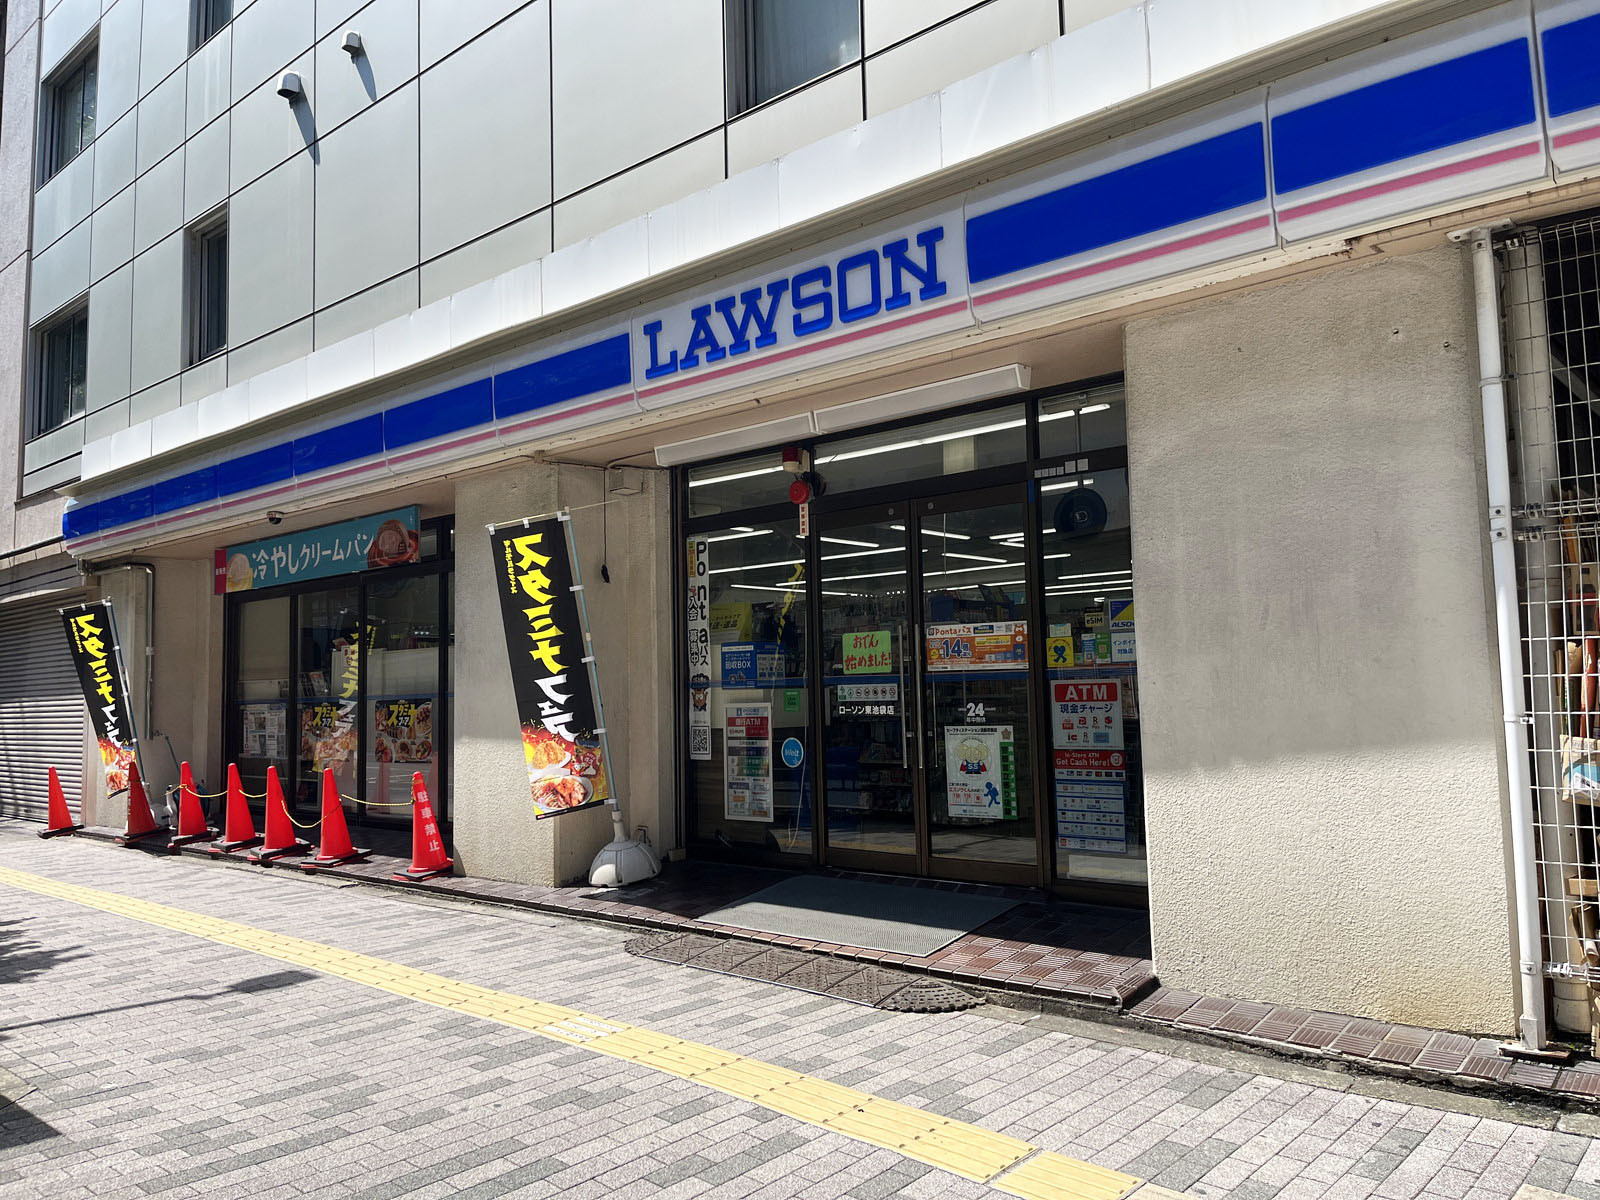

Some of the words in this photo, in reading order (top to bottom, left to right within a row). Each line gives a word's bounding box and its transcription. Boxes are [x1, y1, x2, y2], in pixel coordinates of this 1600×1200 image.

[643, 226, 947, 380] LAWSON
[252, 533, 375, 580] 冷やしクリームパン
[942, 637, 963, 659] 14
[1065, 684, 1107, 701] ATM
[838, 705, 895, 715] ローソン東池袋店
[966, 702, 985, 717] 24
[1060, 703, 1113, 714] 現金チャージ
[1056, 758, 1068, 766] Get
[1070, 758, 1088, 766] Cash
[1089, 759, 1110, 767] Here!
[416, 791, 441, 852] 駐車禁止
